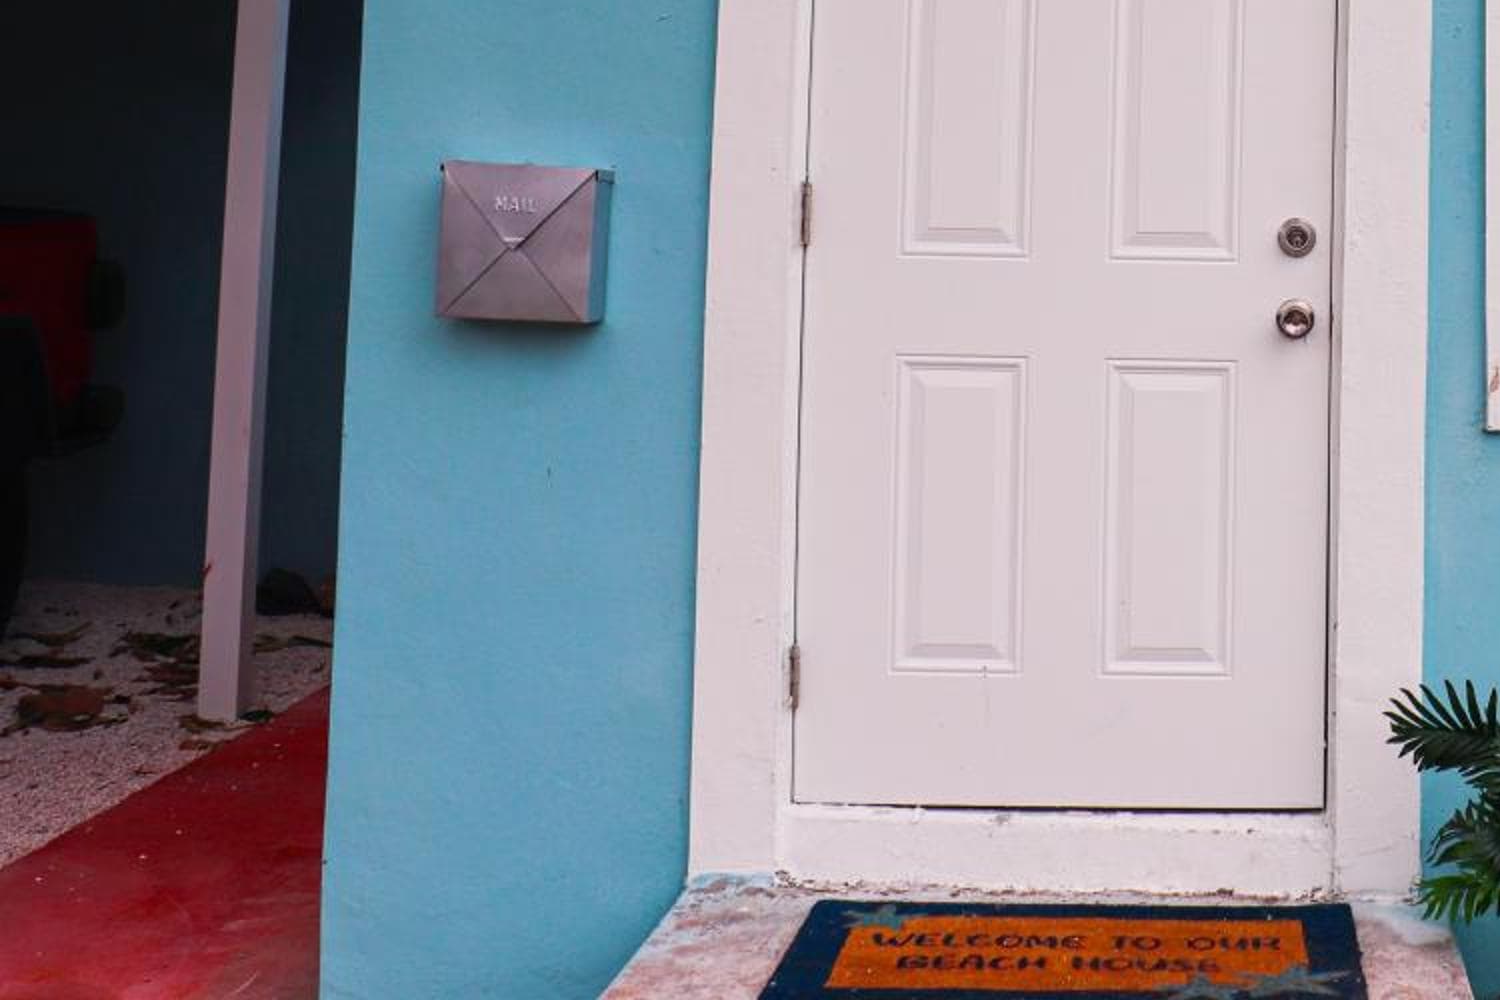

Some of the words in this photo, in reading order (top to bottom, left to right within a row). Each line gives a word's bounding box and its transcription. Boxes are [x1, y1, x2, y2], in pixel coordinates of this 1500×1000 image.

[494, 195, 538, 213] MAIL
[872, 932, 1088, 949] WELCOME
[1112, 934, 1162, 950] TO
[1186, 935, 1281, 951] OUR
[896, 954, 1047, 970] BEACH
[1071, 956, 1221, 972] HOUSE
